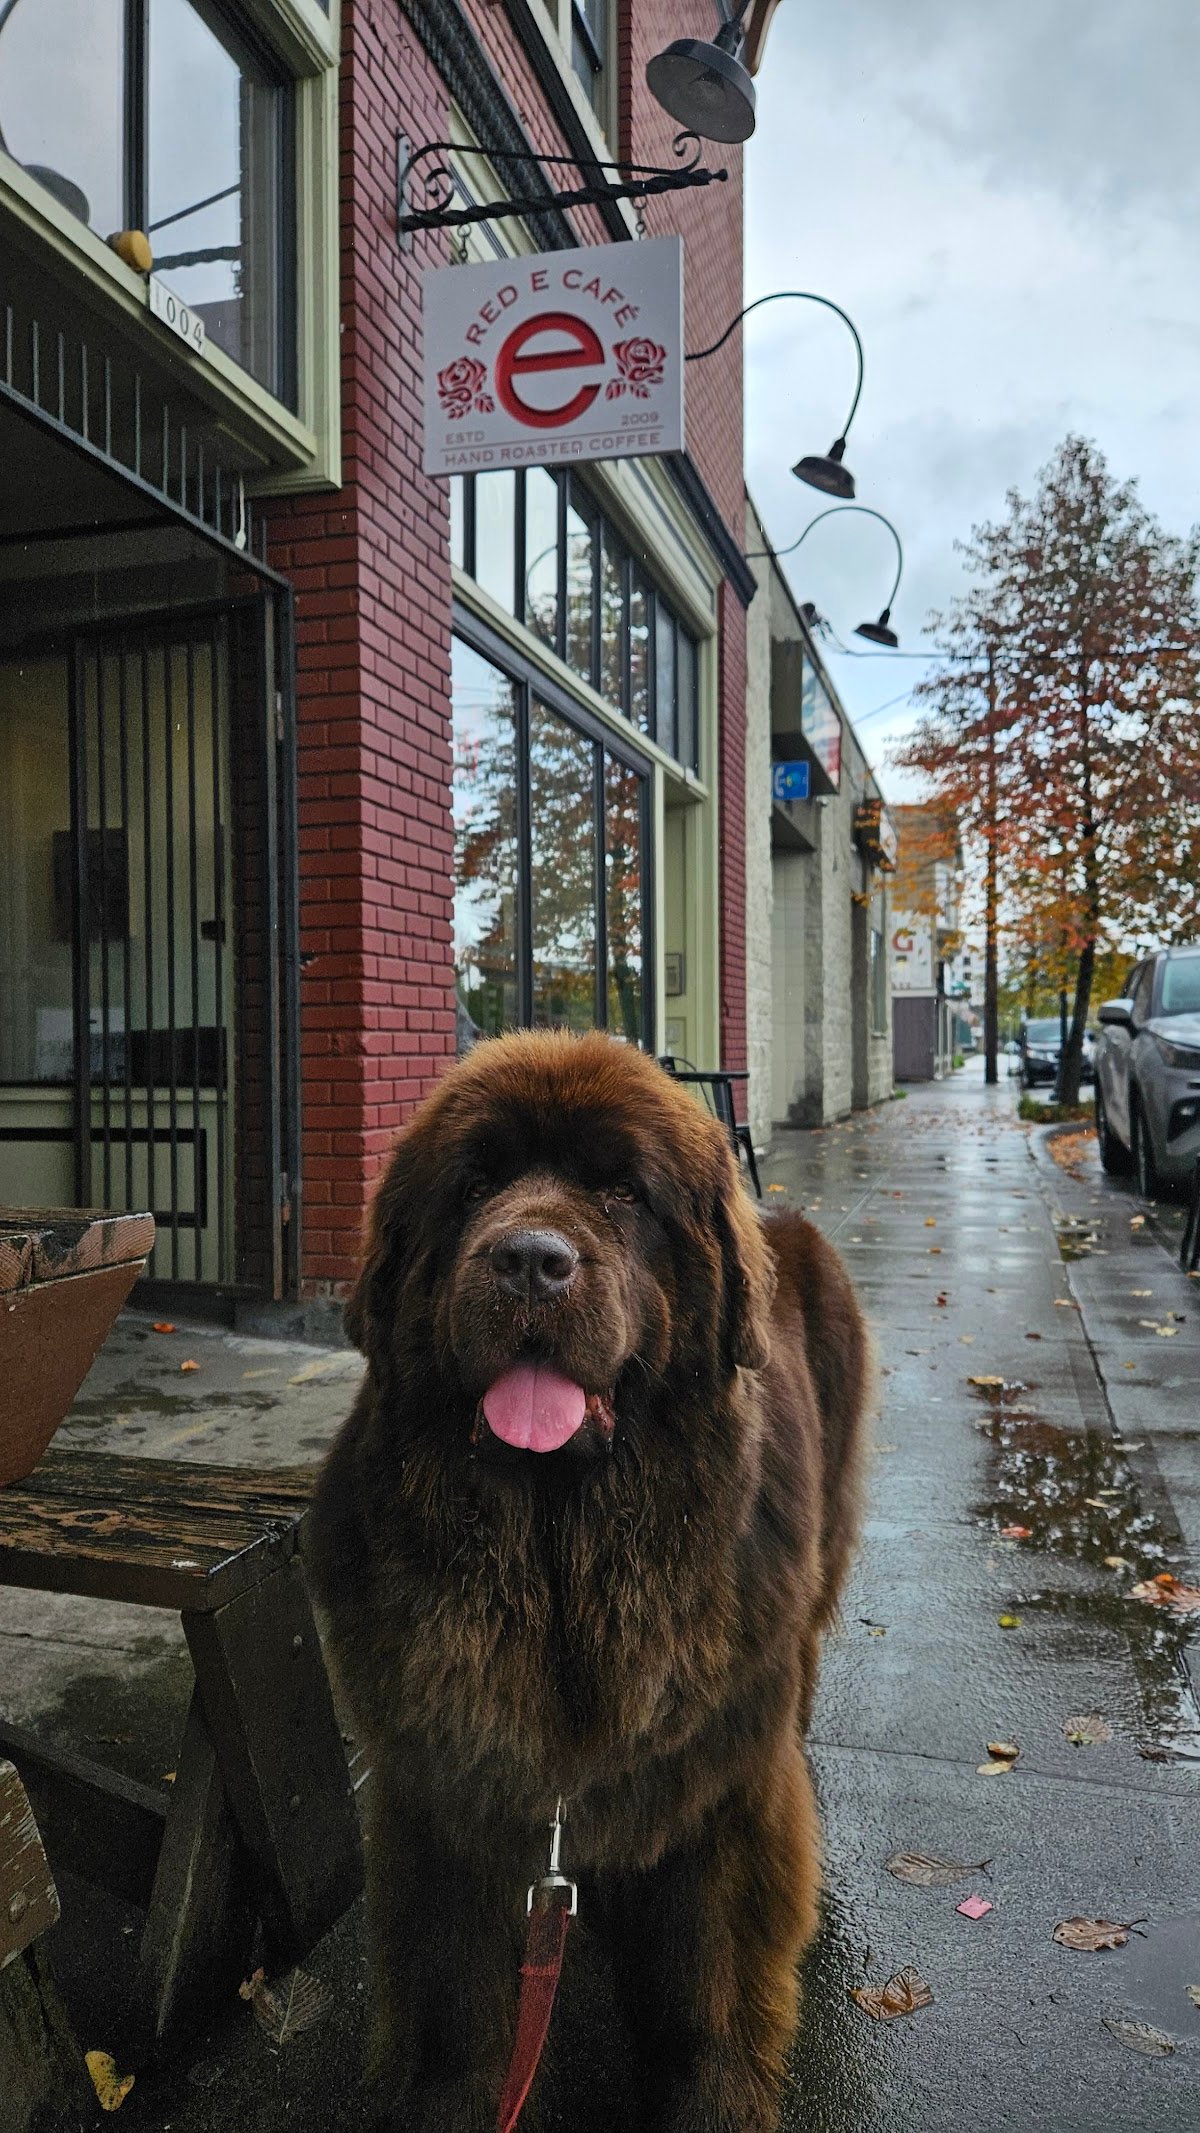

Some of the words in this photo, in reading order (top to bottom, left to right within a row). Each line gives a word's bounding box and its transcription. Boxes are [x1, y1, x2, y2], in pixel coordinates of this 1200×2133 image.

[465, 286, 519, 346] RED
[530, 269, 550, 293] E
[562, 269, 641, 329] CAFÉ
[494, 310, 606, 430] e
[444, 449, 494, 468] HAND
[500, 439, 583, 461] ROASTED
[589, 431, 662, 451] COFFEE
[445, 430, 486, 445] ESTD
[621, 411, 660, 427] 2009
